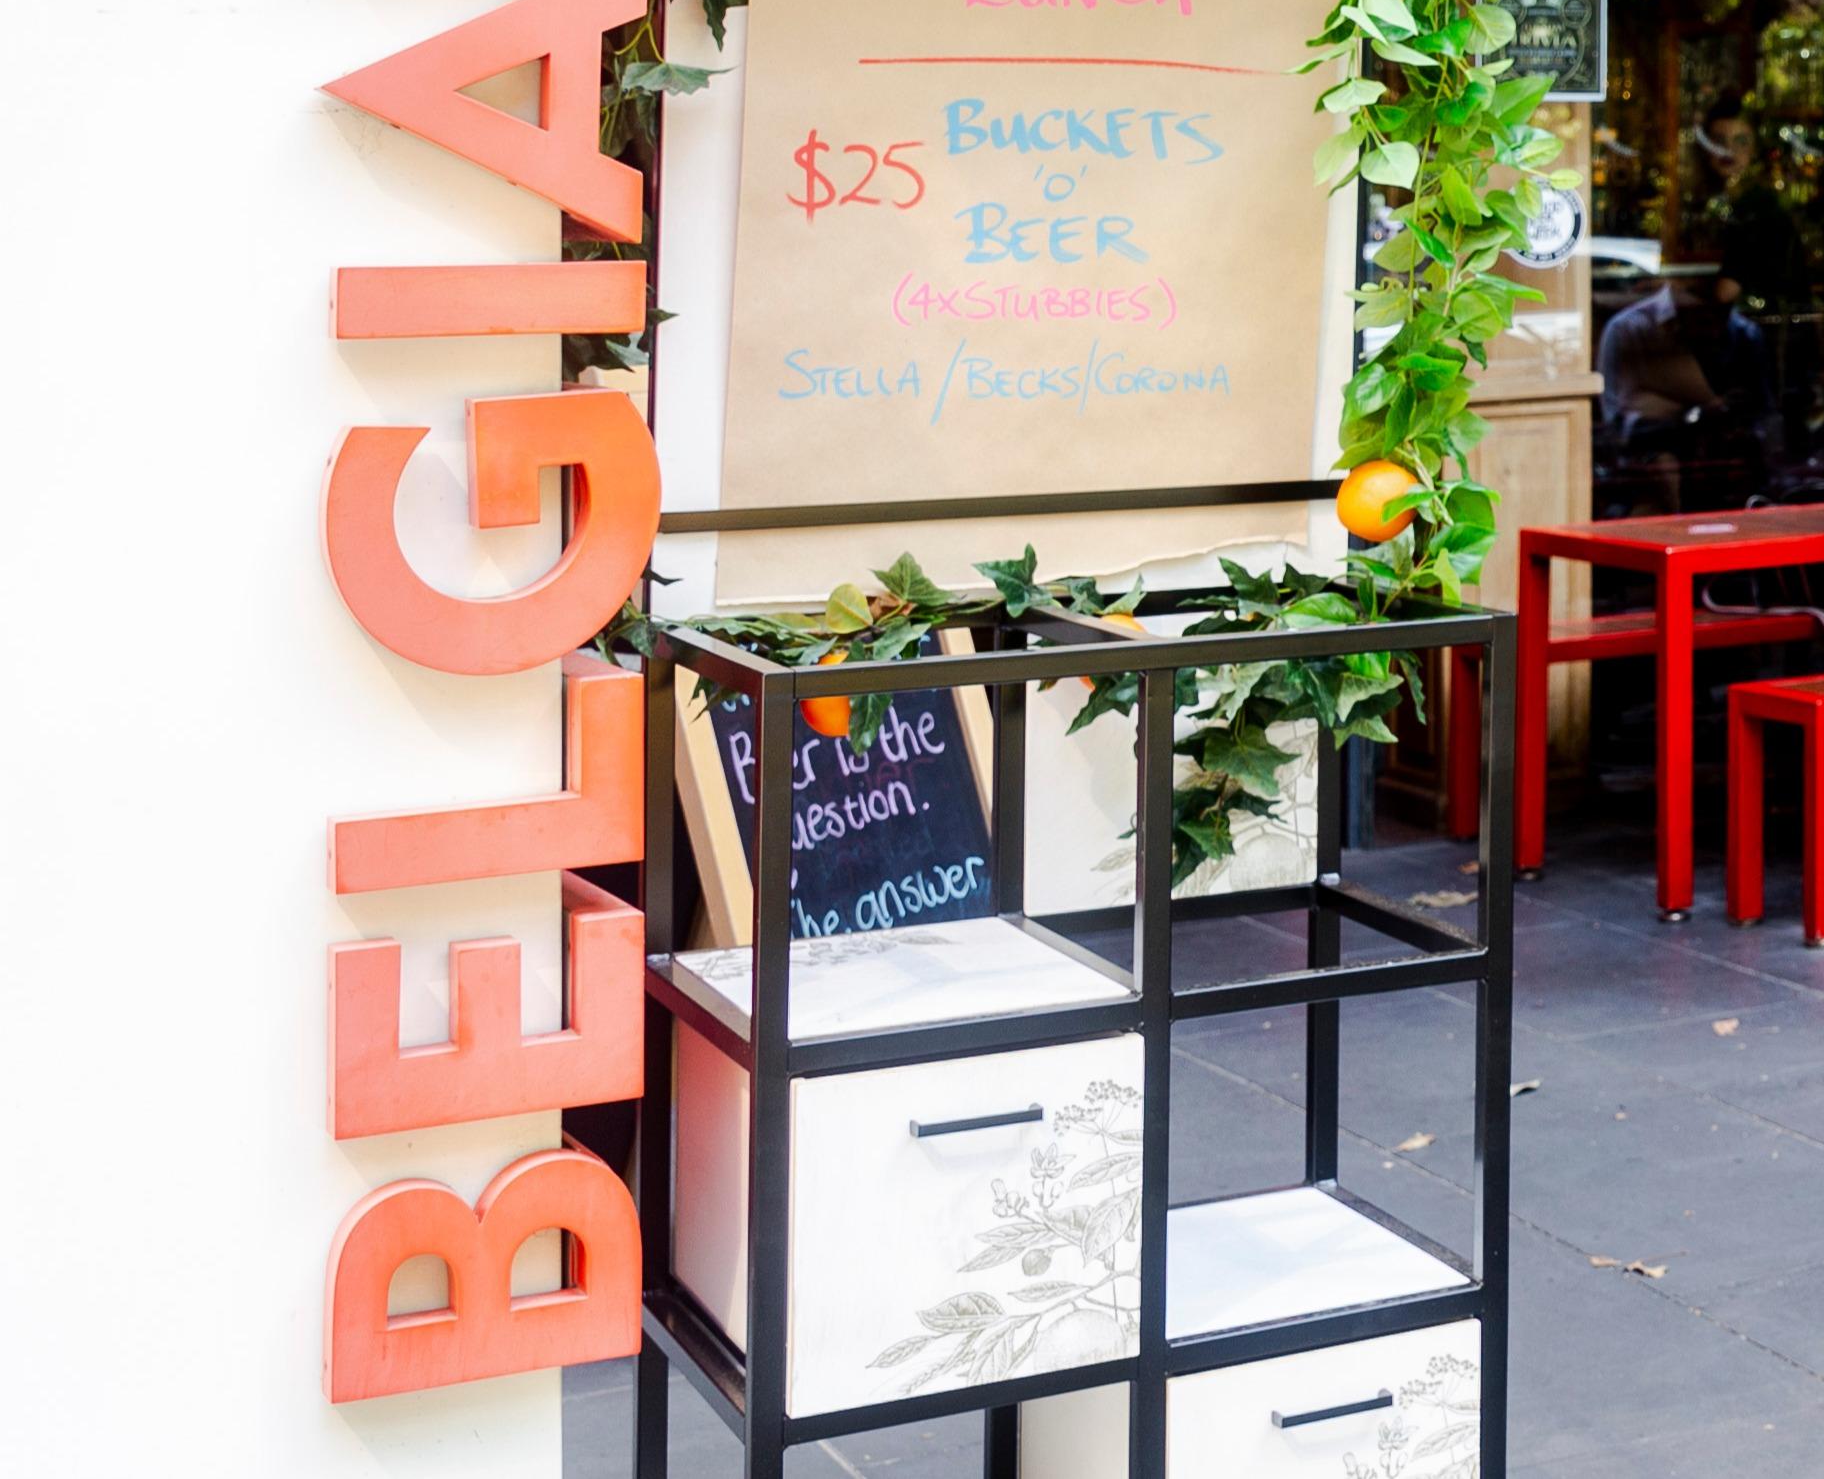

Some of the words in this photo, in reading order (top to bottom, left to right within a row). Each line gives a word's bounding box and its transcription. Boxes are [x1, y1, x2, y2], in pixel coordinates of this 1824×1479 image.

[941, 98, 1226, 165] BUCKETS
[786, 128, 926, 225] $25
[954, 201, 1150, 264] BEER
[879, 705, 945, 763] the
[790, 780, 930, 850] uestion.
[855, 856, 985, 930] answer
